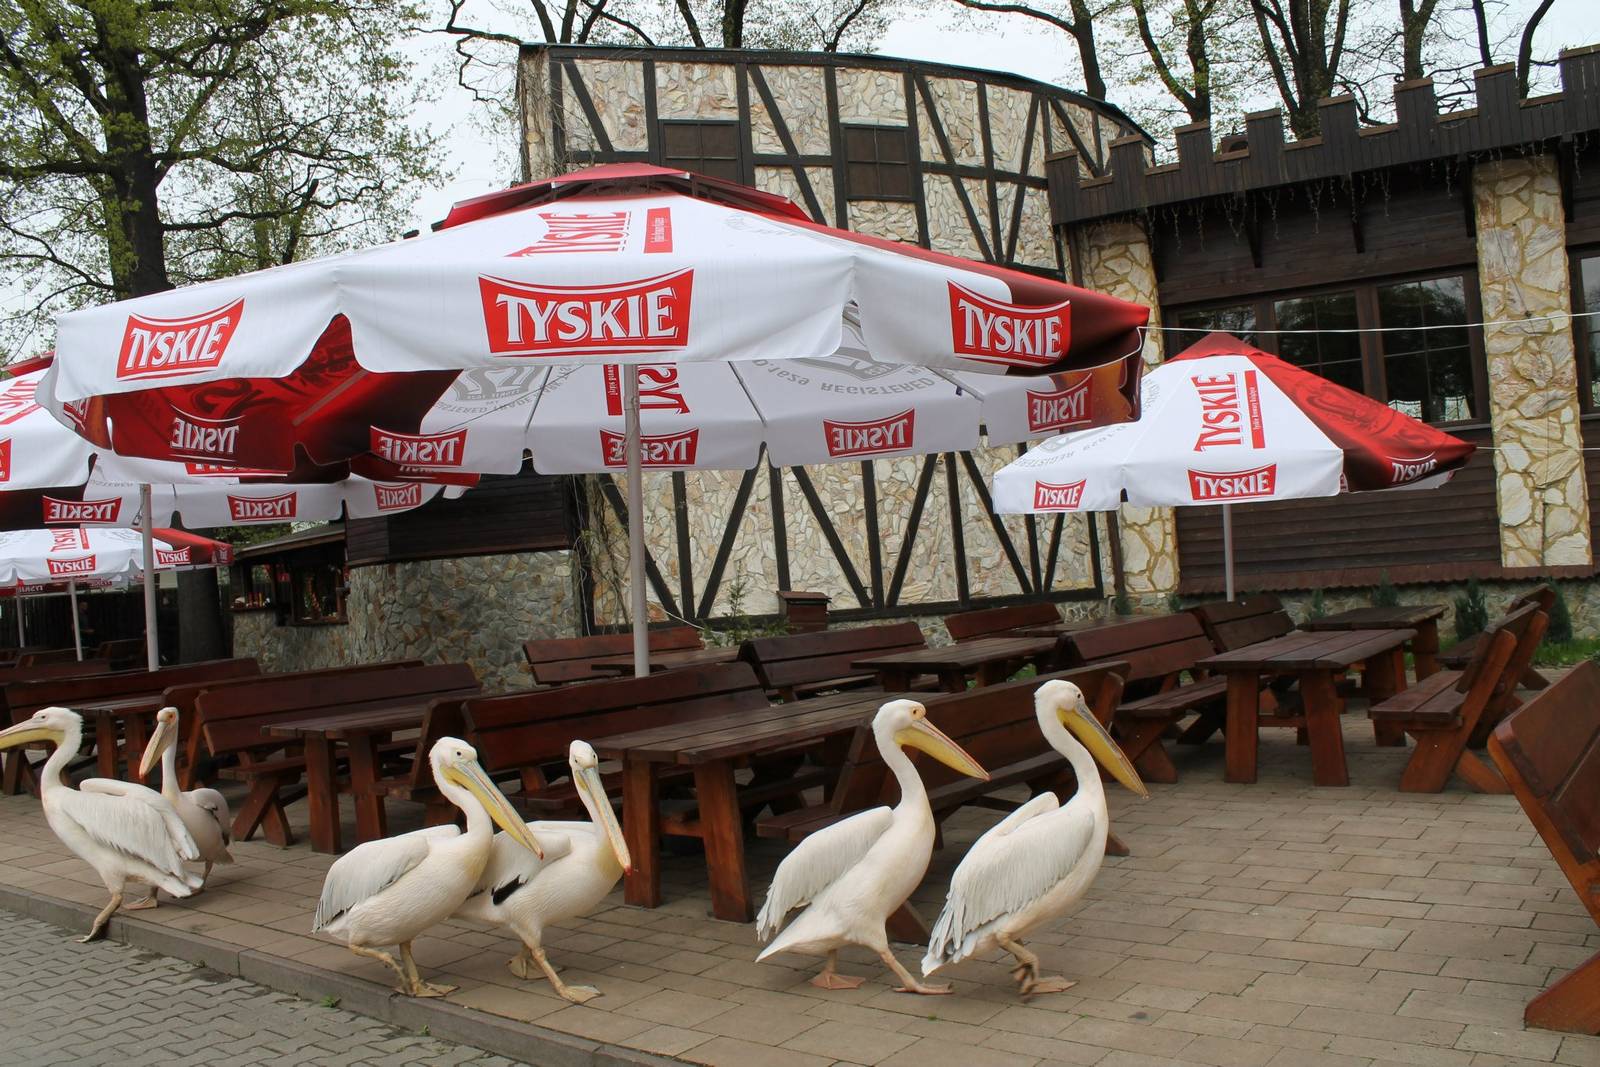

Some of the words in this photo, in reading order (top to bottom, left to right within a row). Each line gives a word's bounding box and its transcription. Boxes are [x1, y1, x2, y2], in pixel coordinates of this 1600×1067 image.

[503, 211, 632, 257] TYSKIE
[495, 287, 678, 344] TYSKIE
[957, 299, 1062, 358] TYSKIE
[125, 316, 230, 368] TYSKIE
[1191, 372, 1244, 452] TYSKIE
[1038, 485, 1080, 505] TYSKIE
[1197, 470, 1271, 497] TYSKIE
[52, 558, 94, 573] TYSKIE
[158, 550, 190, 563] TYSKIE
